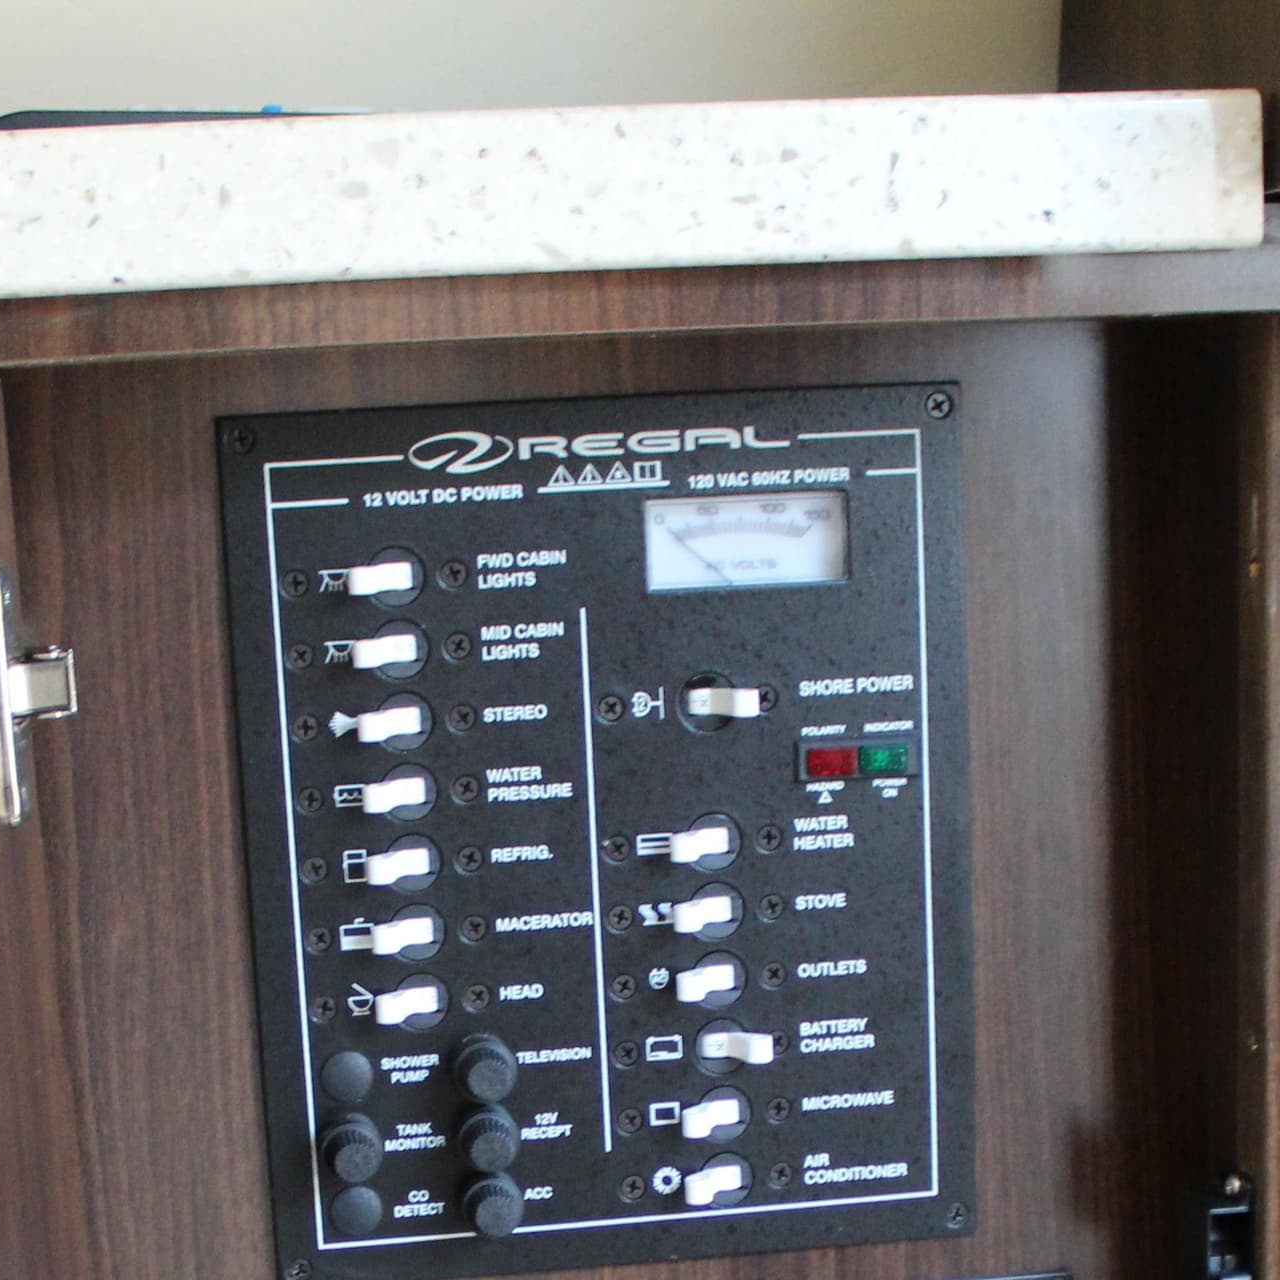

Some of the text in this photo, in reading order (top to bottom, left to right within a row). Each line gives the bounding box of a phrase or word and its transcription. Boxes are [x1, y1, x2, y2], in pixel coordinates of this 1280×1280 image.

[519, 426, 791, 461] REGAL
[688, 467, 850, 490] 120 VAC 60HZ POWER
[363, 484, 523, 508] 12 VOLT DC POWER
[477, 550, 567, 569] FWD CABIN
[478, 572, 536, 590] LIGHTS
[481, 622, 564, 641] MID CABIN
[481, 643, 540, 661] LIGHTS
[799, 675, 914, 697] SHORE POWER
[483, 704, 548, 722] STEREO
[863, 720, 914, 733] INDICATOR
[486, 766, 542, 784] WATER
[487, 782, 573, 803] PRESSURE
[793, 815, 848, 833] WATER
[793, 833, 854, 851] HEATER
[491, 845, 553, 864] REFRIG.
[795, 893, 847, 911] STOVE
[495, 911, 593, 932] MACERATOR
[797, 959, 868, 978] OUTLETS
[499, 983, 544, 1001] HEAD
[800, 1018, 868, 1036] BATTERY
[800, 1034, 875, 1053] CHARGER
[381, 1053, 439, 1071] SHOWER
[517, 1047, 592, 1065] TELEVISION
[391, 1070, 429, 1084] PUMP
[802, 1090, 895, 1111] MICROWAVE
[535, 1112, 559, 1126] 12V
[396, 1122, 432, 1137] TANK
[521, 1124, 572, 1140] RECEPT
[385, 1135, 446, 1152] MONITOR
[804, 1153, 830, 1169] AIR
[804, 1163, 908, 1186] CONDITIONER
[408, 1190, 429, 1202] CO
[524, 1186, 553, 1200] ACC
[394, 1202, 445, 1219] DETECT
